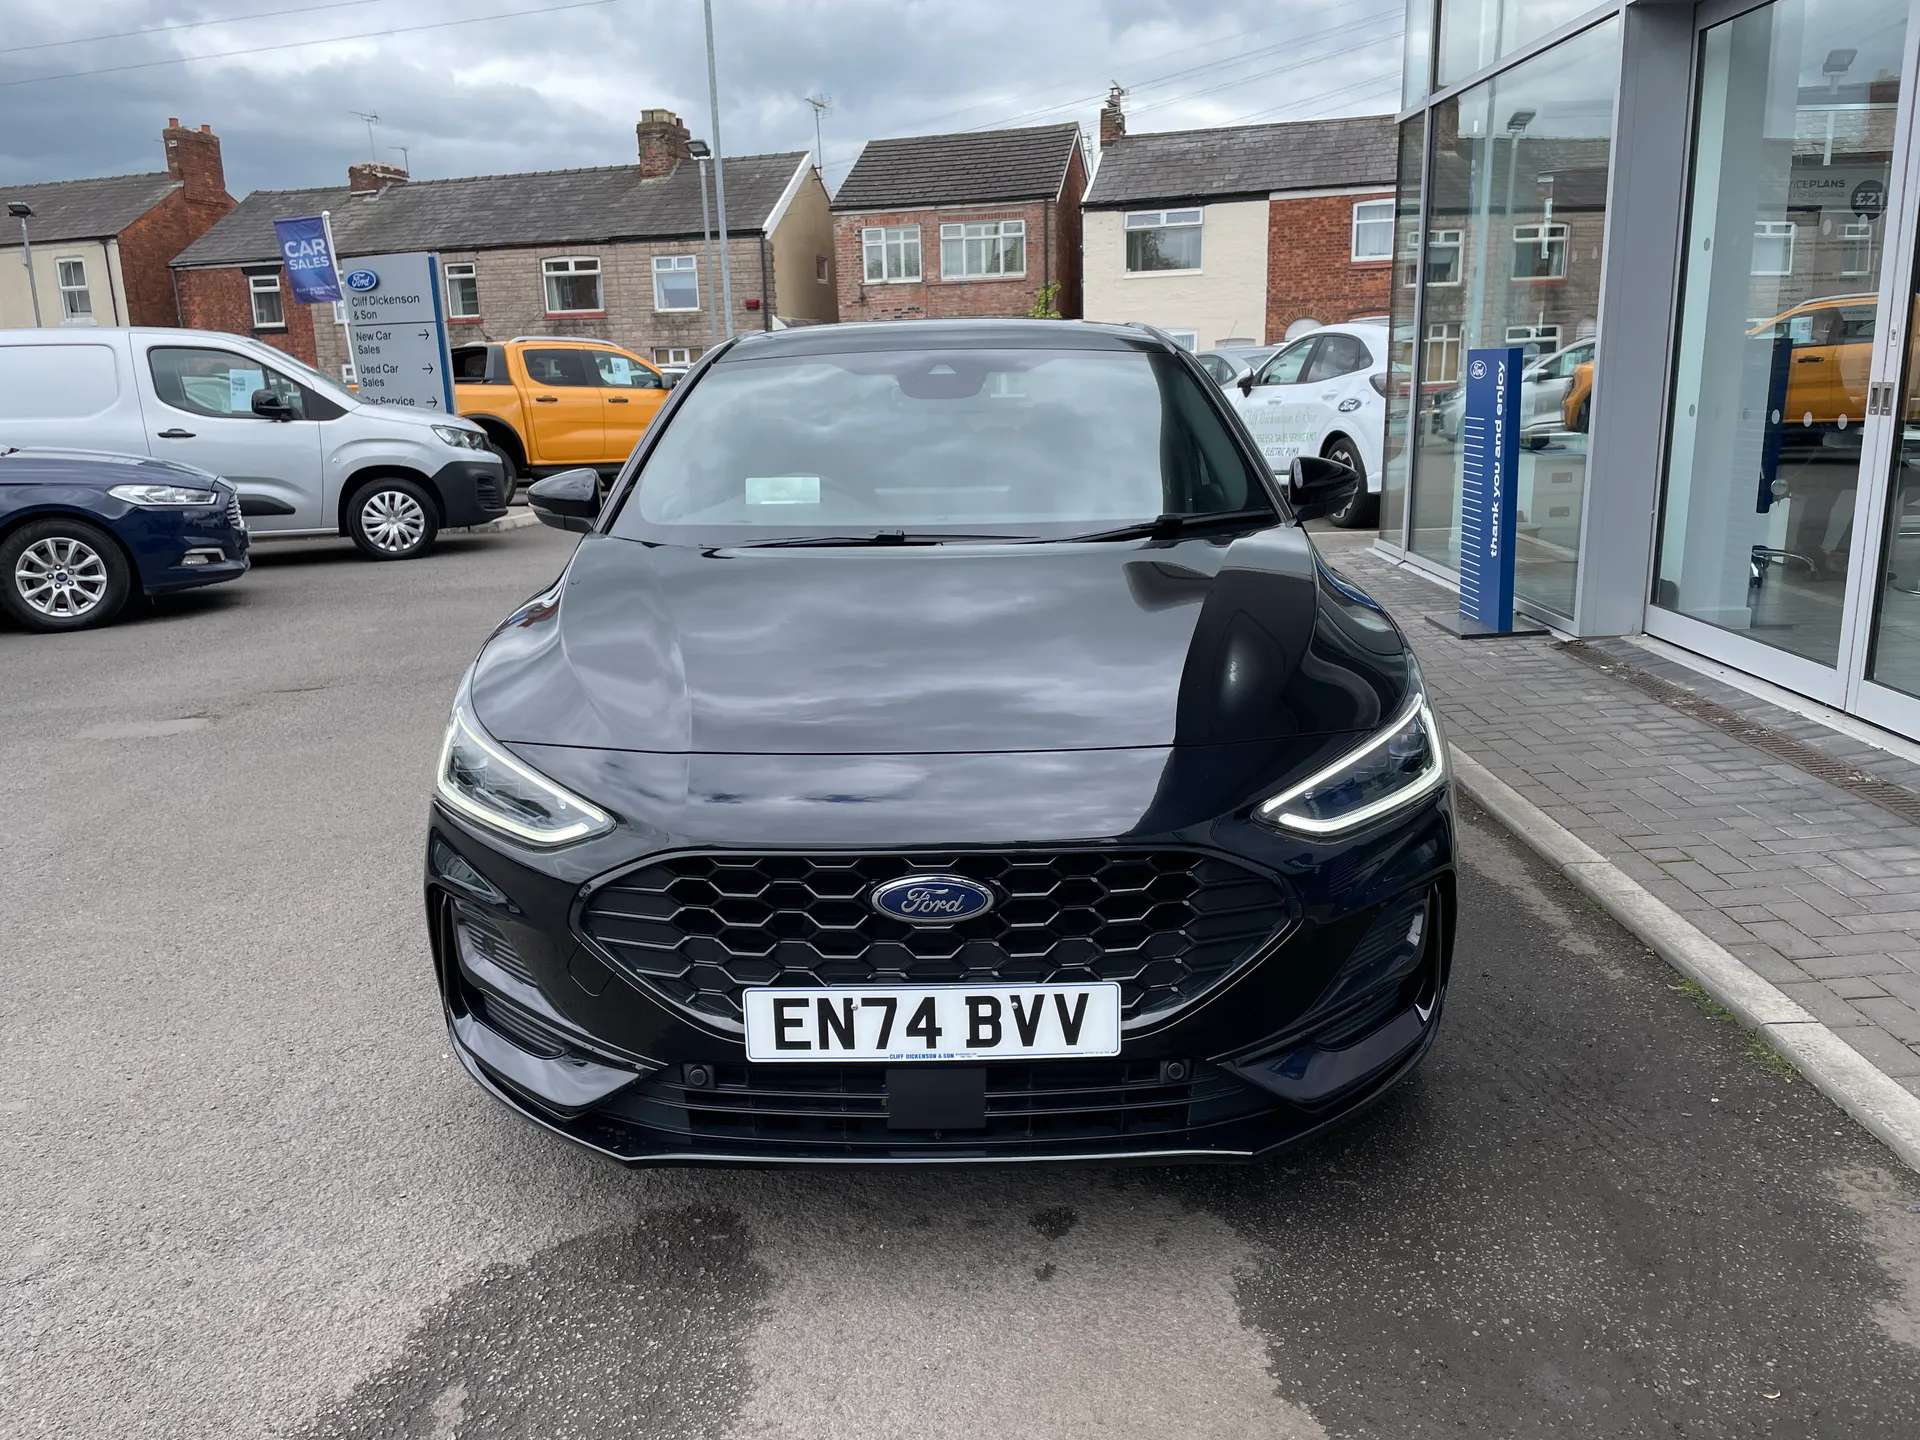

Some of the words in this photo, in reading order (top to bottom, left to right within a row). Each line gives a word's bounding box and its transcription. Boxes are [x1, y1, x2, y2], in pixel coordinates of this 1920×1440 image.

[285, 239, 327, 257] CAR
[289, 256, 330, 270] SALES
[351, 295, 368, 307] Cliff
[369, 295, 420, 306] Dickenson
[353, 310, 359, 320] &
[361, 310, 378, 320] Son
[356, 331, 374, 342] New
[376, 330, 392, 341] Car
[358, 344, 381, 355] Sales
[360, 364, 381, 374] Used
[382, 363, 399, 374] Car
[362, 377, 385, 388] Sales
[1496, 361, 1506, 416] enjoy
[380, 395, 415, 406] Service
[1494, 419, 1502, 459] and
[1493, 462, 1501, 498] you
[1490, 502, 1499, 557] thank
[901, 887, 965, 912] Ford
[773, 997, 942, 1051] EN74
[965, 993, 1089, 1049] BVV
